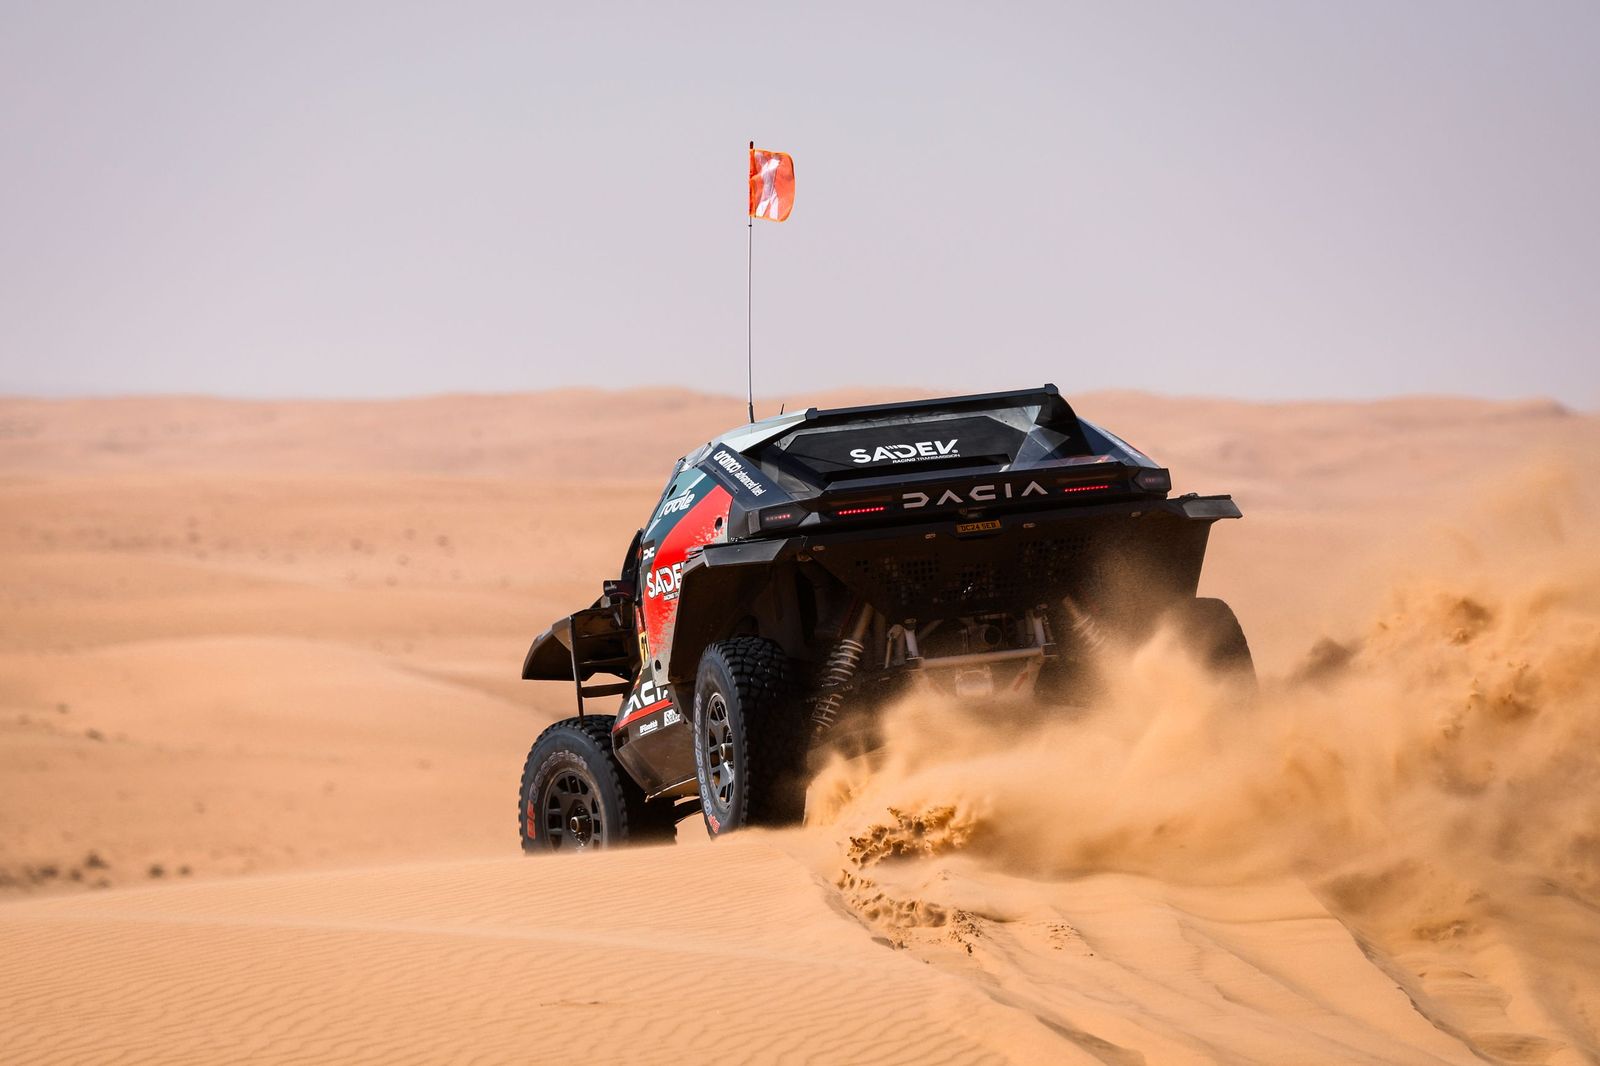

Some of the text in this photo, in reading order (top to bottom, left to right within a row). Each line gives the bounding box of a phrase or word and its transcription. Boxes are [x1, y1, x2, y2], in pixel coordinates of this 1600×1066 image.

[713, 450, 742, 473] aramco
[849, 439, 958, 464] SADEV
[902, 480, 1049, 509] DACIA
[646, 562, 685, 598] SADE
[622, 680, 668, 719] ACI
